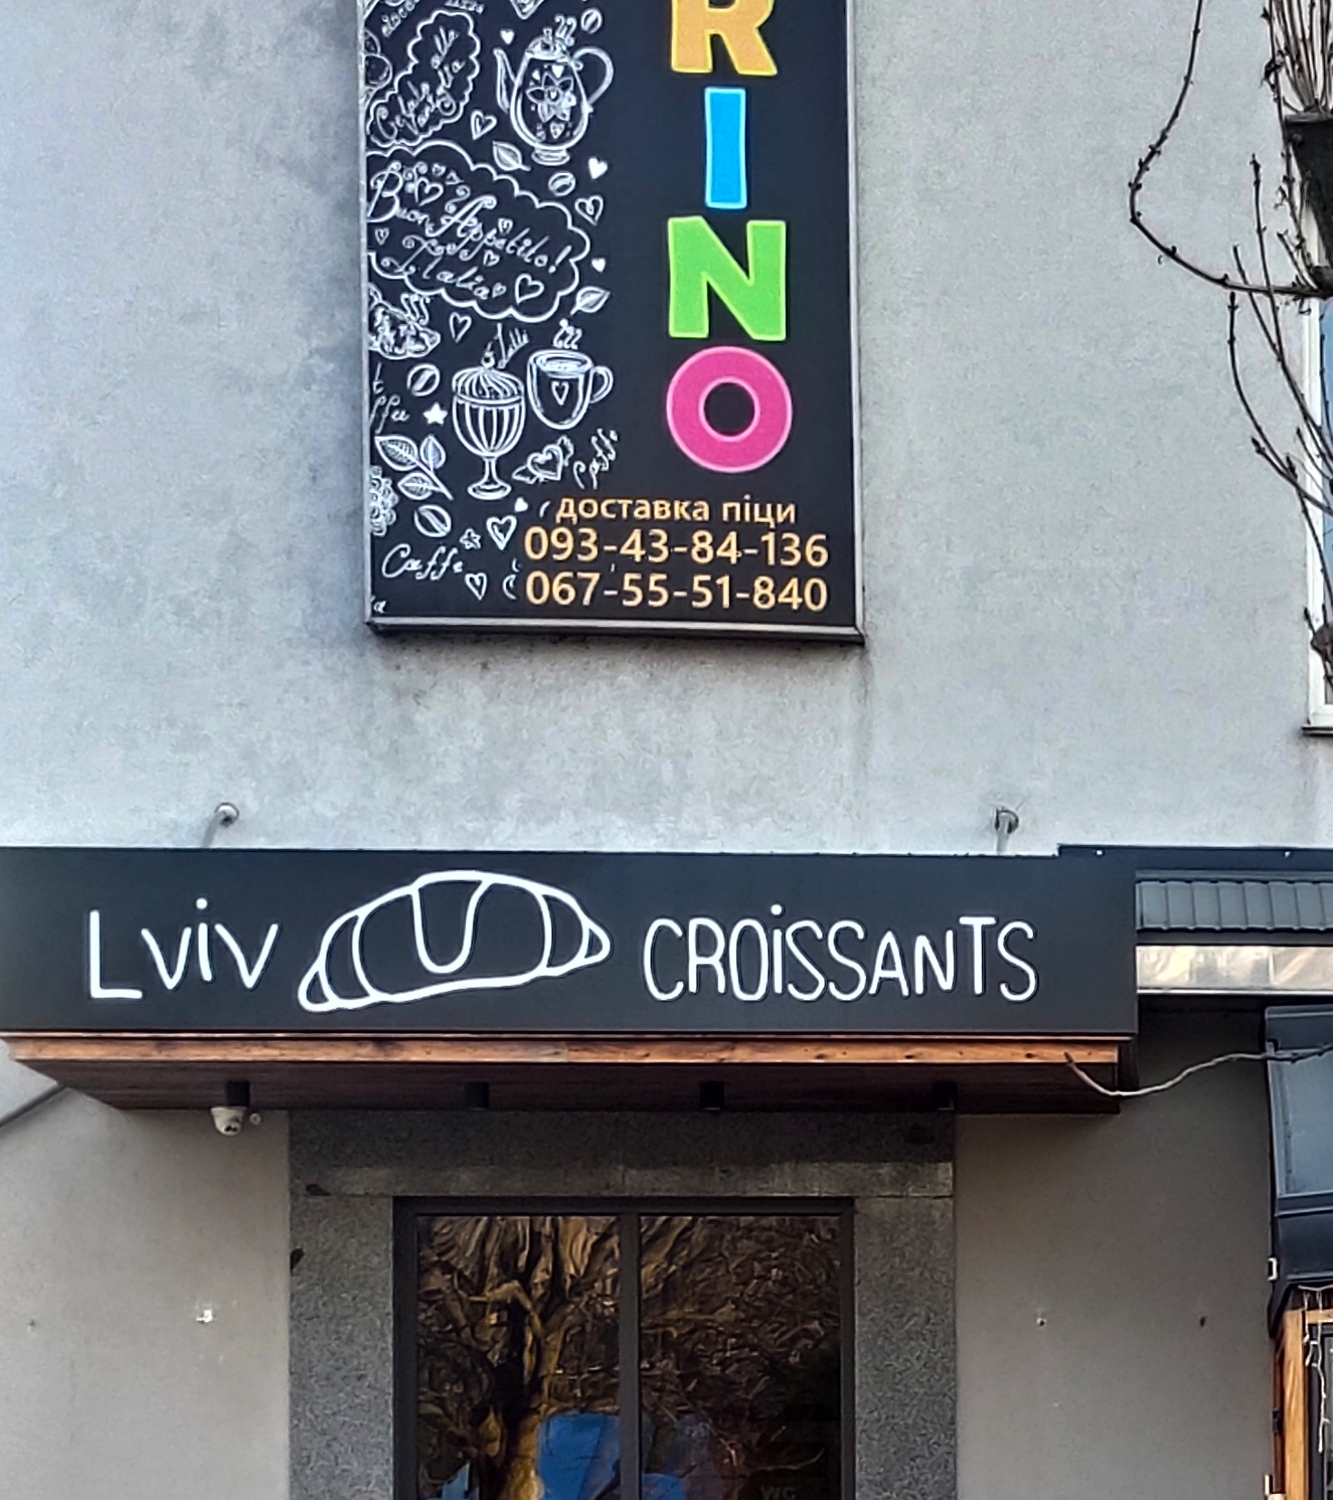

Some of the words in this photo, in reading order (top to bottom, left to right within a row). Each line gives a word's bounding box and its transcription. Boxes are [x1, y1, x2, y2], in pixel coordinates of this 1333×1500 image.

[555, 497, 710, 525] доставка
[722, 493, 796, 529] піци
[523, 525, 829, 568] 093-43-84-136
[524, 570, 829, 612] 067-55-51-840
[89, 897, 279, 1000] Lviv
